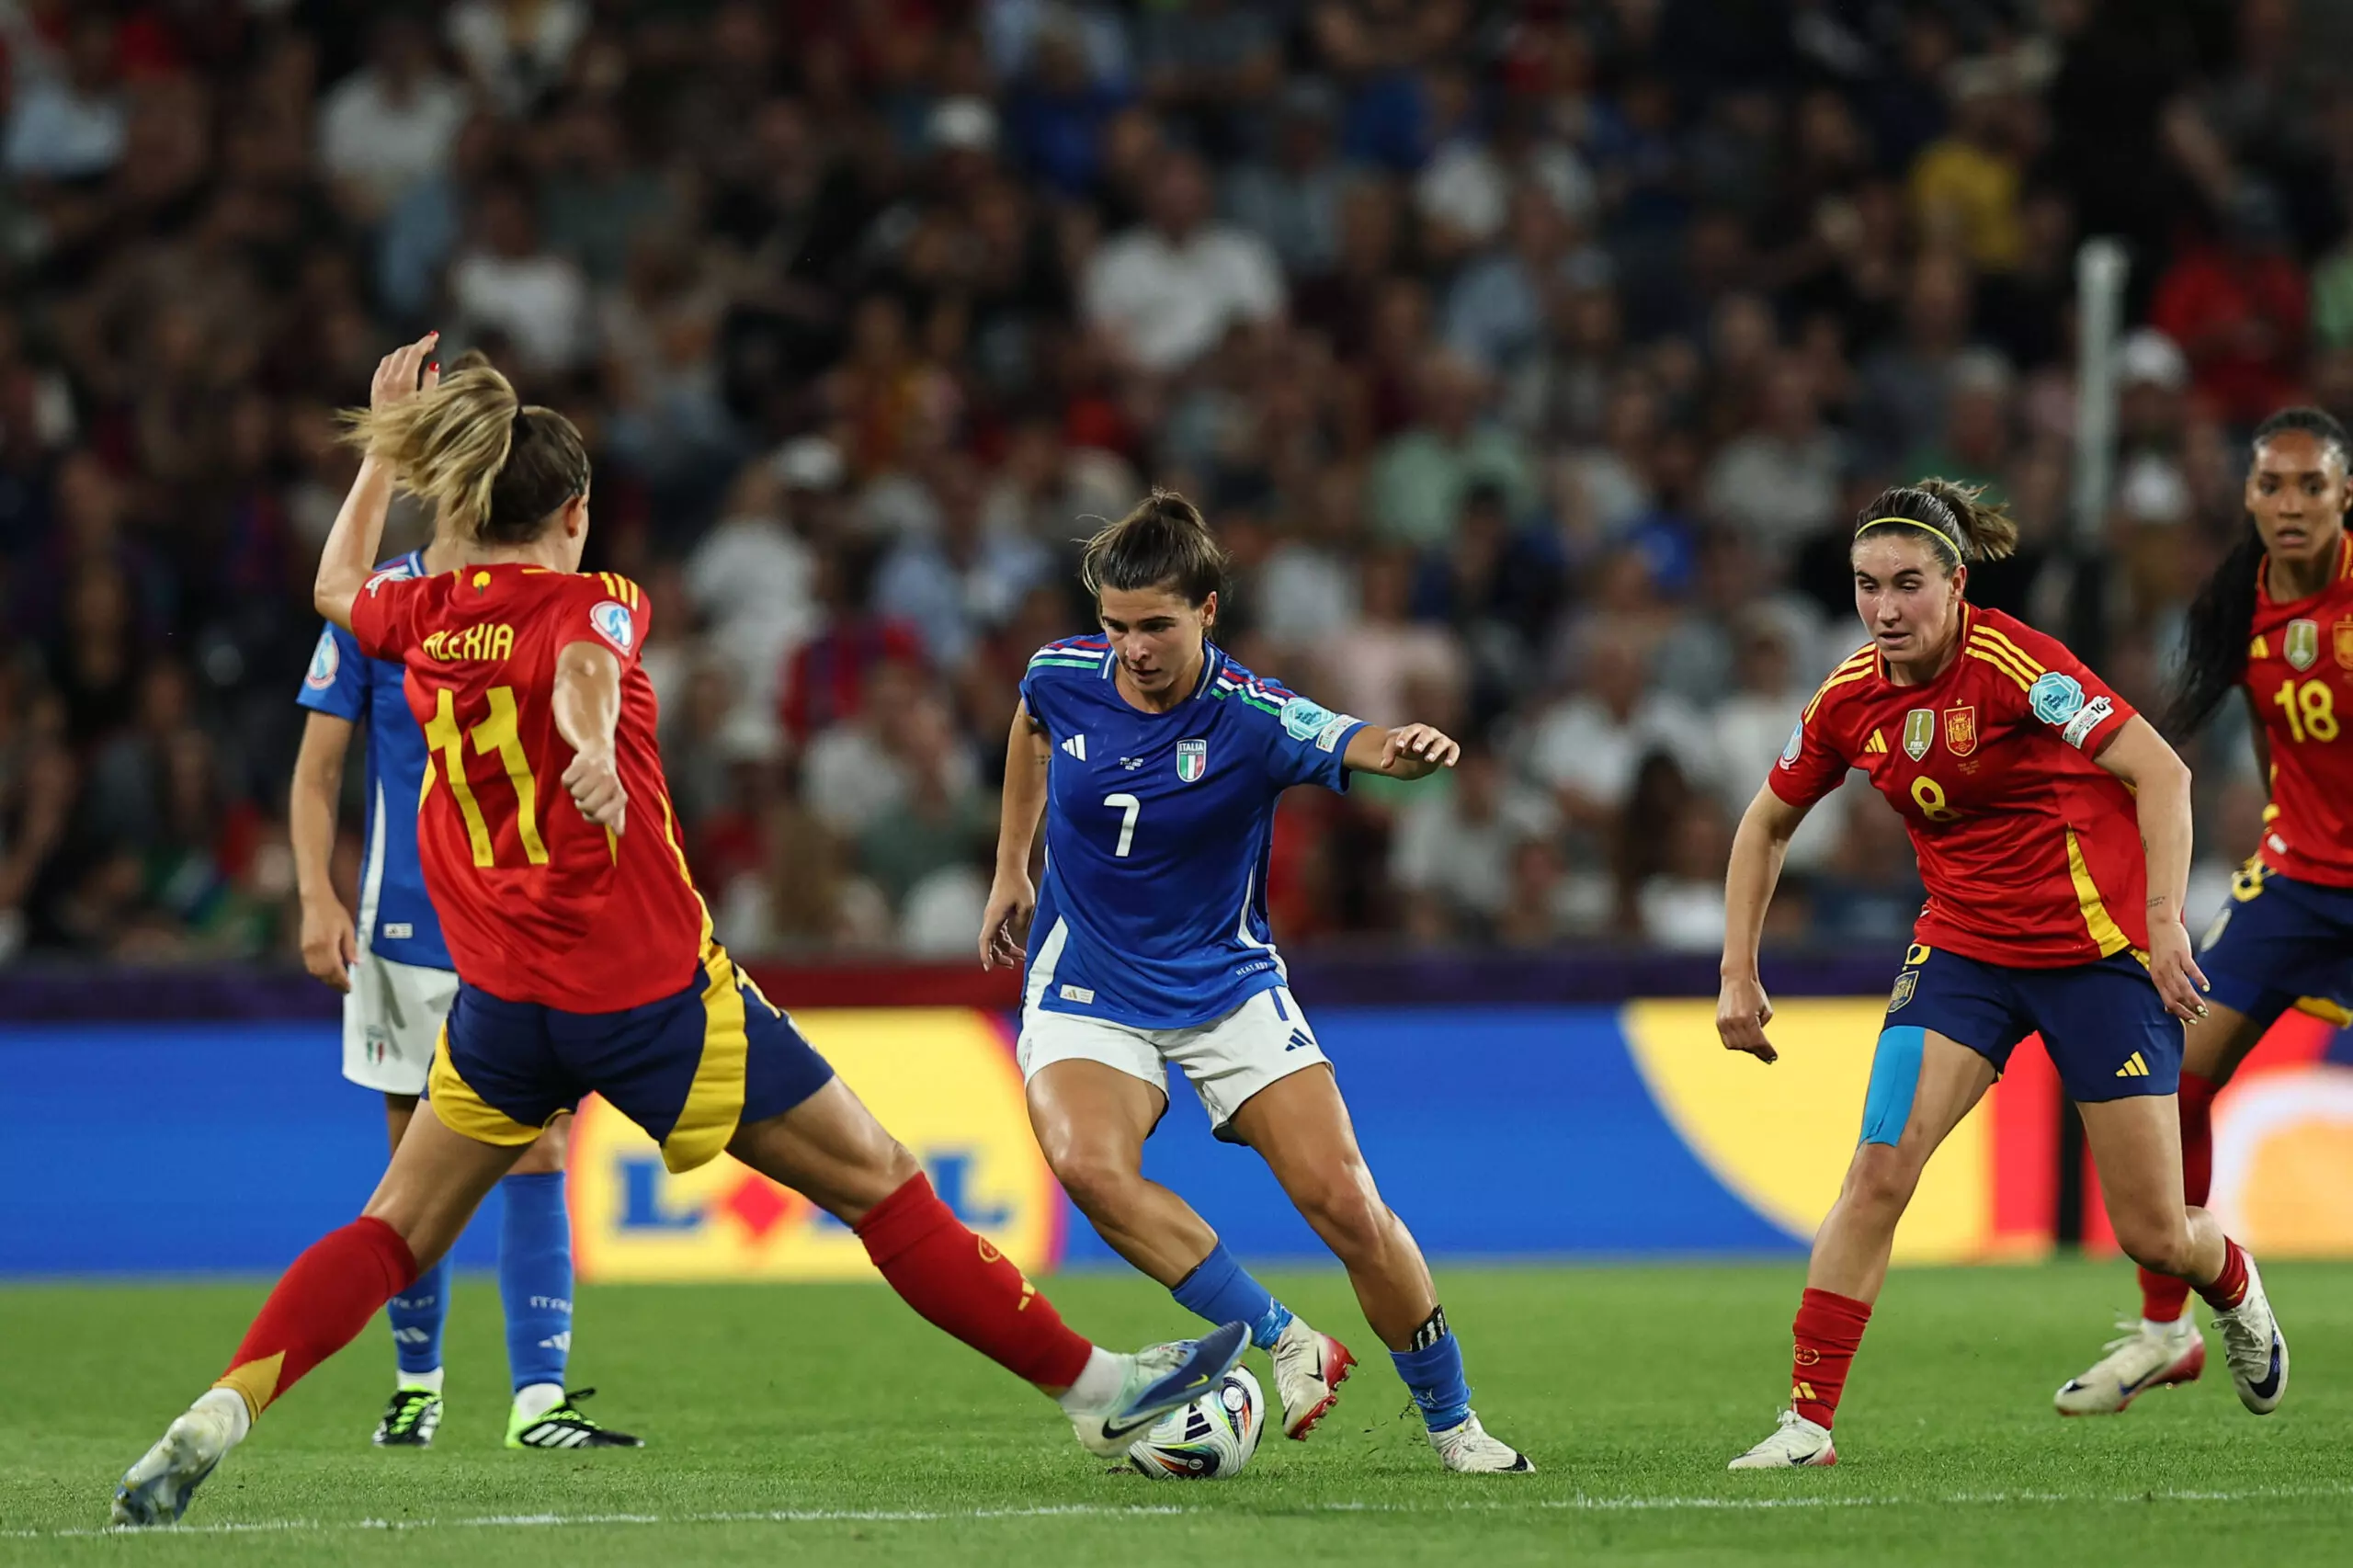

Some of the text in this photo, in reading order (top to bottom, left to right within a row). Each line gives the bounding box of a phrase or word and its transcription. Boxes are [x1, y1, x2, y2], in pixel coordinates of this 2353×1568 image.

[2273, 678, 2341, 744] 18
[424, 685, 550, 869] 11
[1179, 743, 1204, 752] ITALIA
[1103, 793, 1141, 858] 7
[1911, 775, 1963, 823] 8
